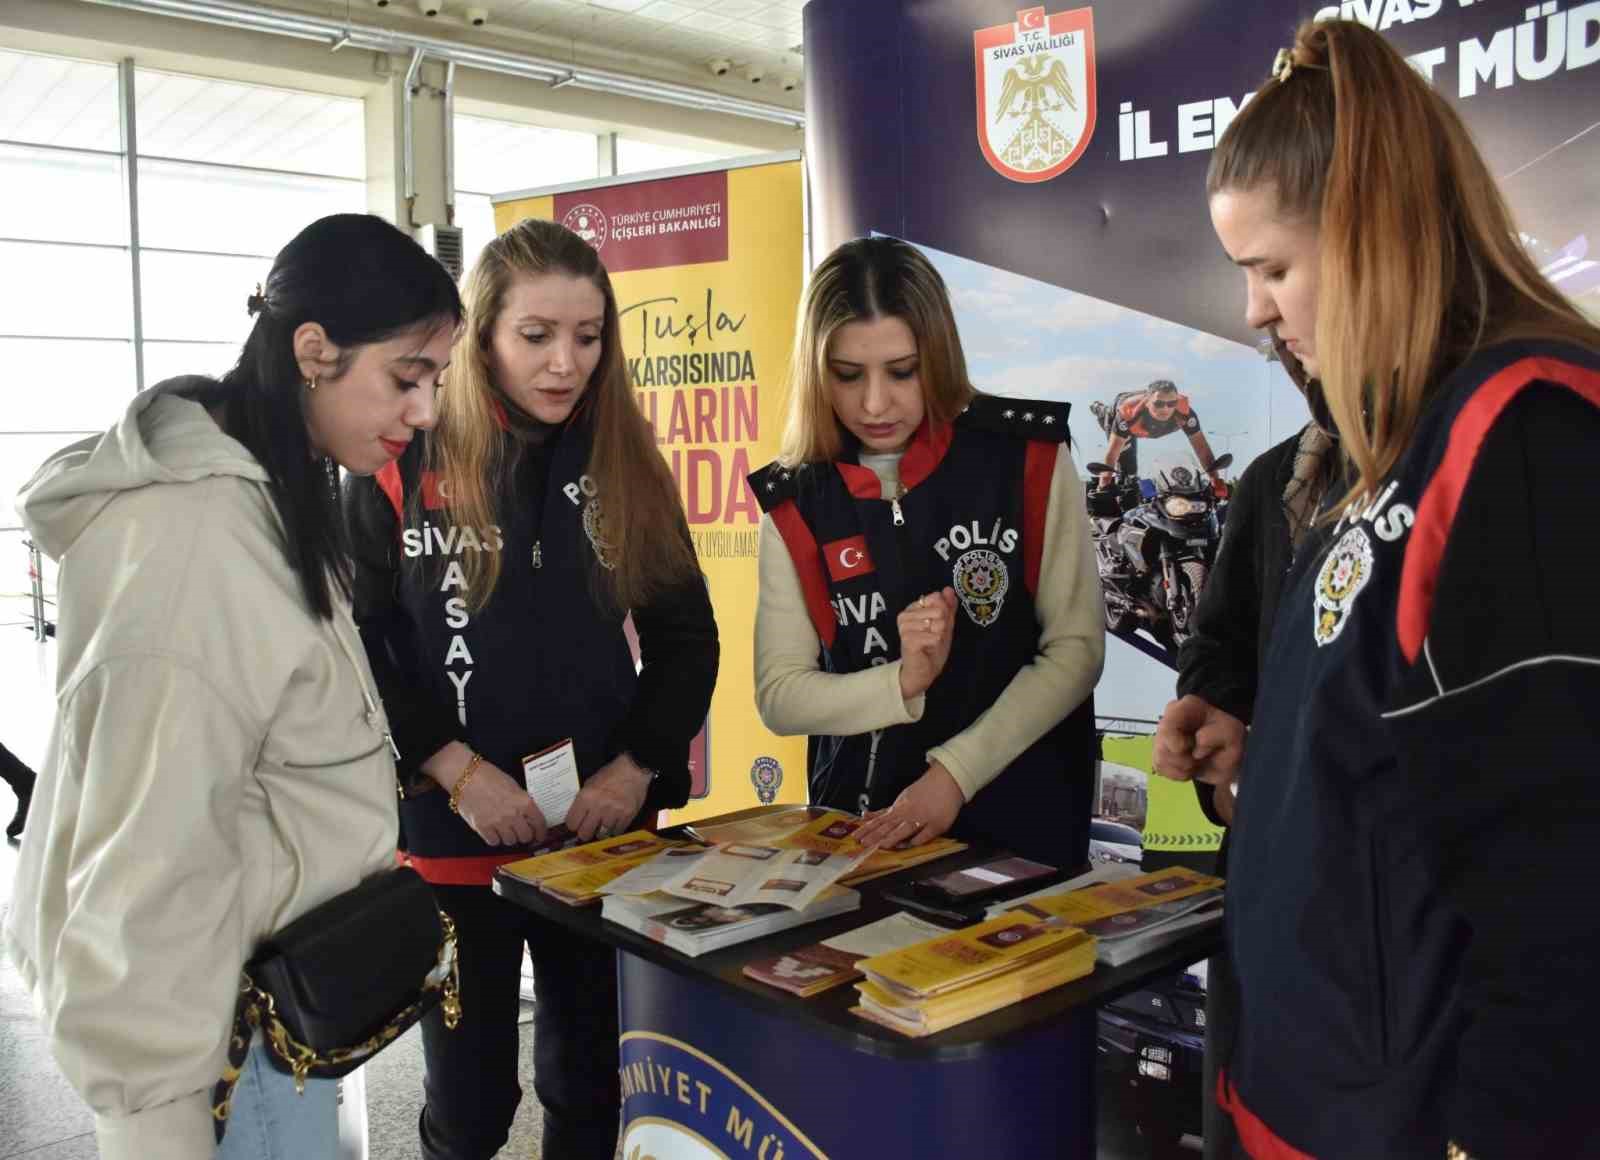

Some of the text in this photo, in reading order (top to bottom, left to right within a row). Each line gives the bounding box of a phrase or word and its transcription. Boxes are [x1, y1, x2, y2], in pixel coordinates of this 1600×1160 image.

[1119, 101, 1168, 161] İL
[610, 202, 720, 226] TÜRKİYE CUMHURİYETİ
[611, 216, 720, 240] İÇİŞLERİ BAKANLIĞI
[402, 521, 504, 557] SİVAS
[933, 517, 1018, 561] POLİS
